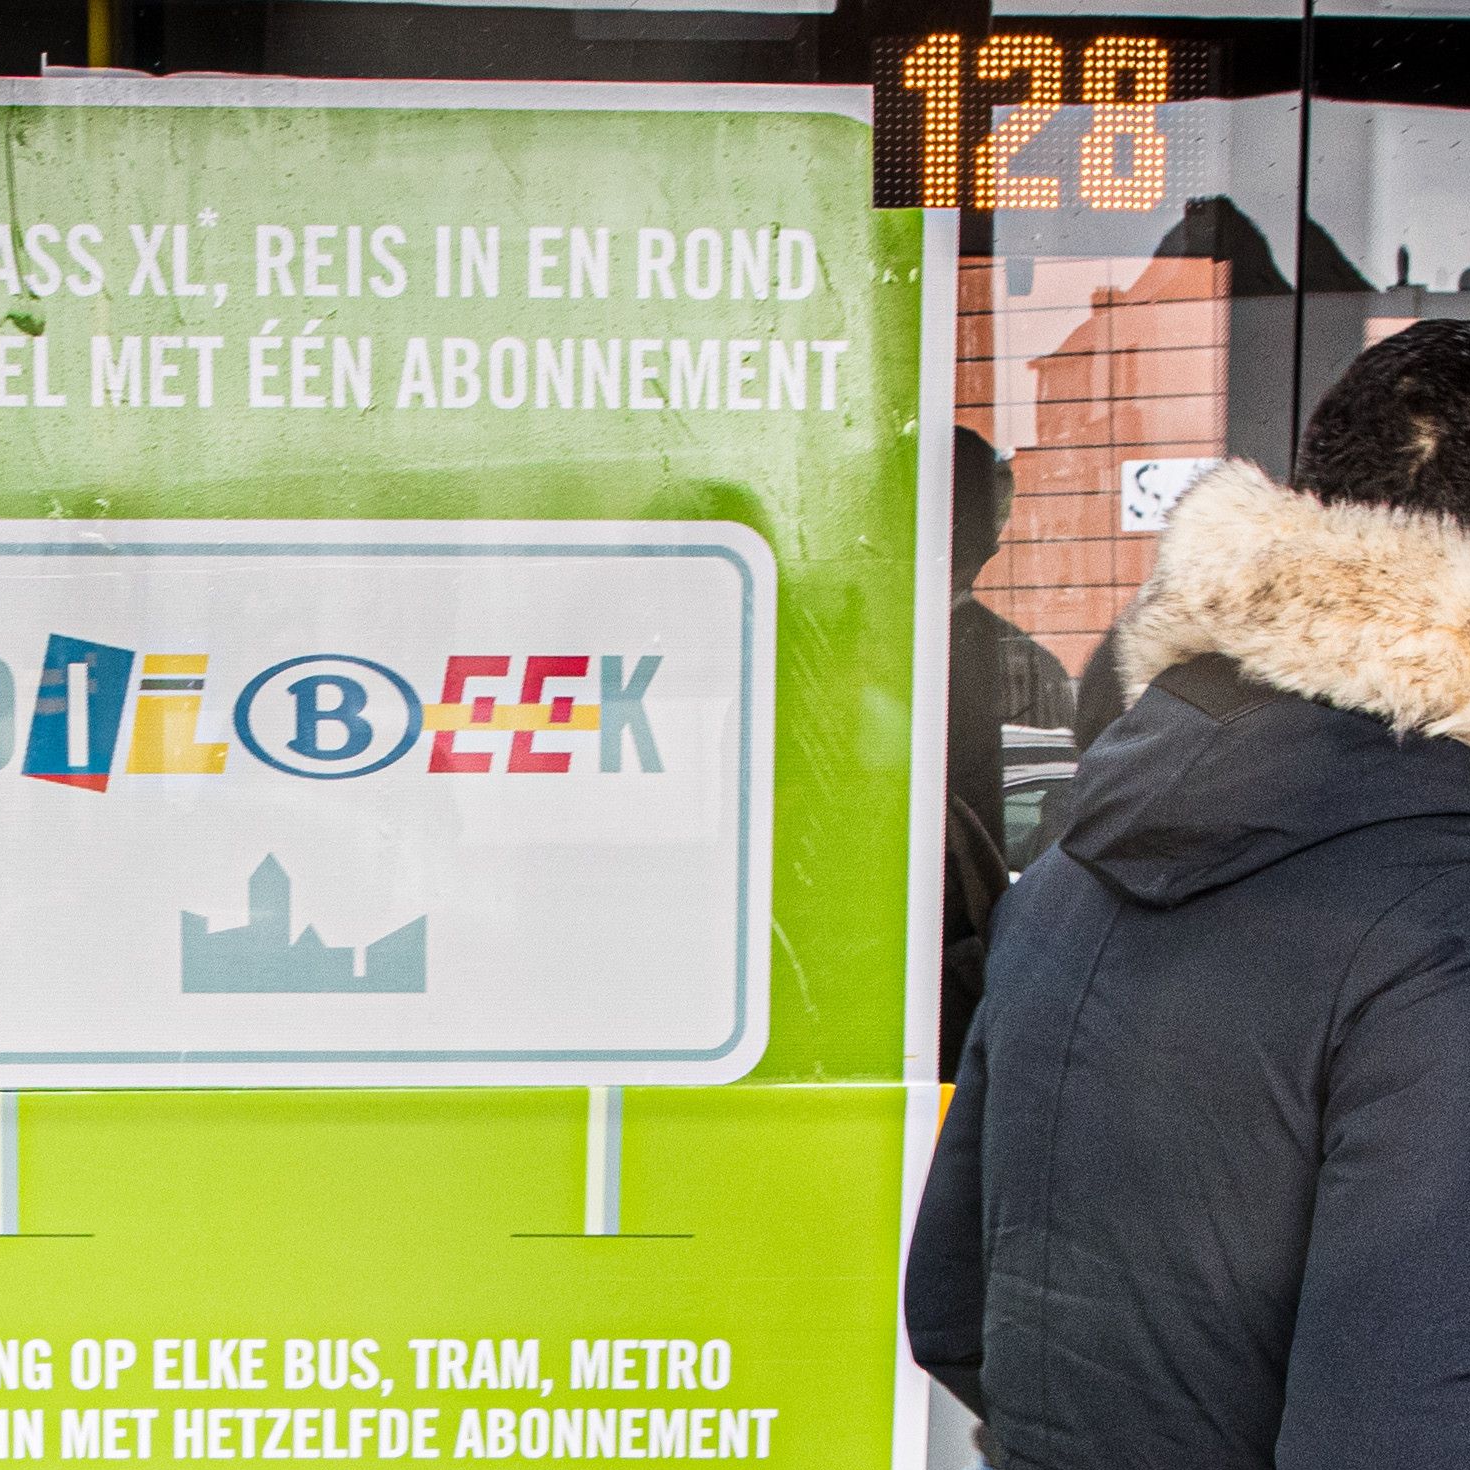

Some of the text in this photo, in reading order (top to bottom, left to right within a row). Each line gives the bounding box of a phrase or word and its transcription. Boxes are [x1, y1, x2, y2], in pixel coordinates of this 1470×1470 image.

[903, 33, 1171, 211] 128
[257, 224, 407, 300] REIS
[437, 226, 500, 300] IN
[530, 226, 608, 300] EN
[638, 226, 818, 302] ROND
[90, 336, 218, 408] MET
[248, 317, 372, 410] ÉÉN
[397, 337, 850, 412] ABONNEMENT
[70, 1338, 137, 1391] OP
[154, 1338, 266, 1391] ELKE
[284, 1338, 394, 1398] BUS,
[409, 1338, 554, 1399] TRAM,
[569, 1338, 732, 1392] METRO
[60, 1409, 159, 1461] MET
[175, 1408, 440, 1460] HETZELFDE
[454, 1408, 778, 1460] ABONNEMENT
